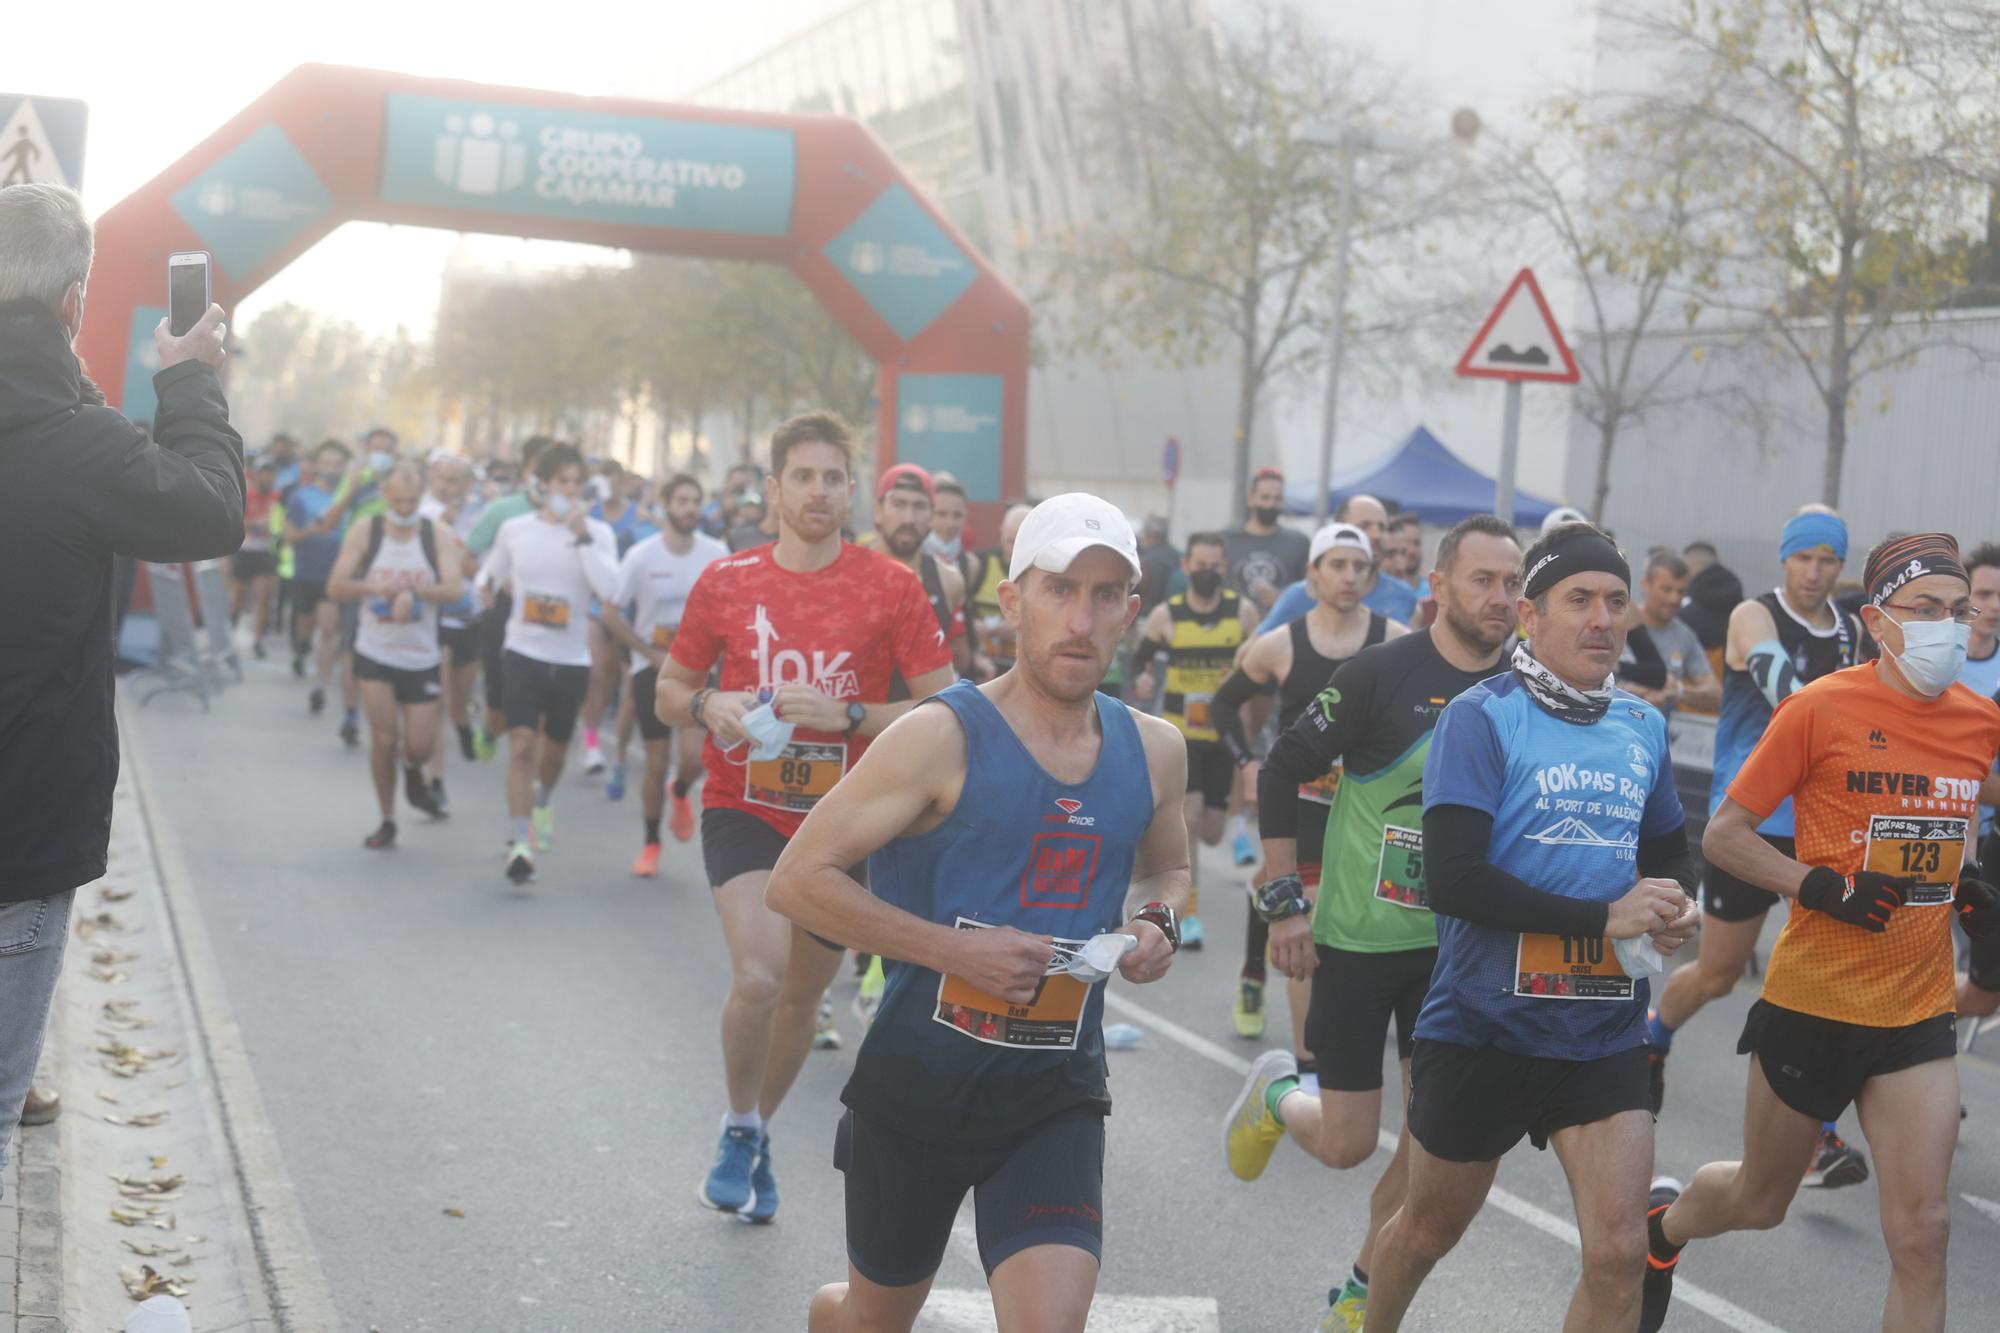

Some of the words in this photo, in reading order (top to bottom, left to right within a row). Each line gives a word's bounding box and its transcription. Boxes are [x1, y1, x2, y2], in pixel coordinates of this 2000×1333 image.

[538, 125, 643, 157] GRUPO
[536, 151, 746, 191] COOPERATIVO
[534, 175, 676, 209] CAJAMAR
[780, 760, 812, 786] 89
[1535, 761, 1579, 795] 10K
[1579, 769, 1615, 792] PAS
[1619, 777, 1646, 808] RAS
[1846, 770, 1930, 797] NEVER
[1933, 776, 1980, 802] STOP
[1535, 796, 1550, 811] AL
[1554, 799, 1585, 813] PORT
[1587, 801, 1601, 815] DE
[1901, 798, 1975, 814] RUNNING
[1873, 819, 1891, 832] 10K
[1891, 821, 1906, 830] PAS
[1906, 822, 1921, 833] RAS
[1900, 842, 1940, 873] 123
[1007, 1005, 1029, 1018] BxM
